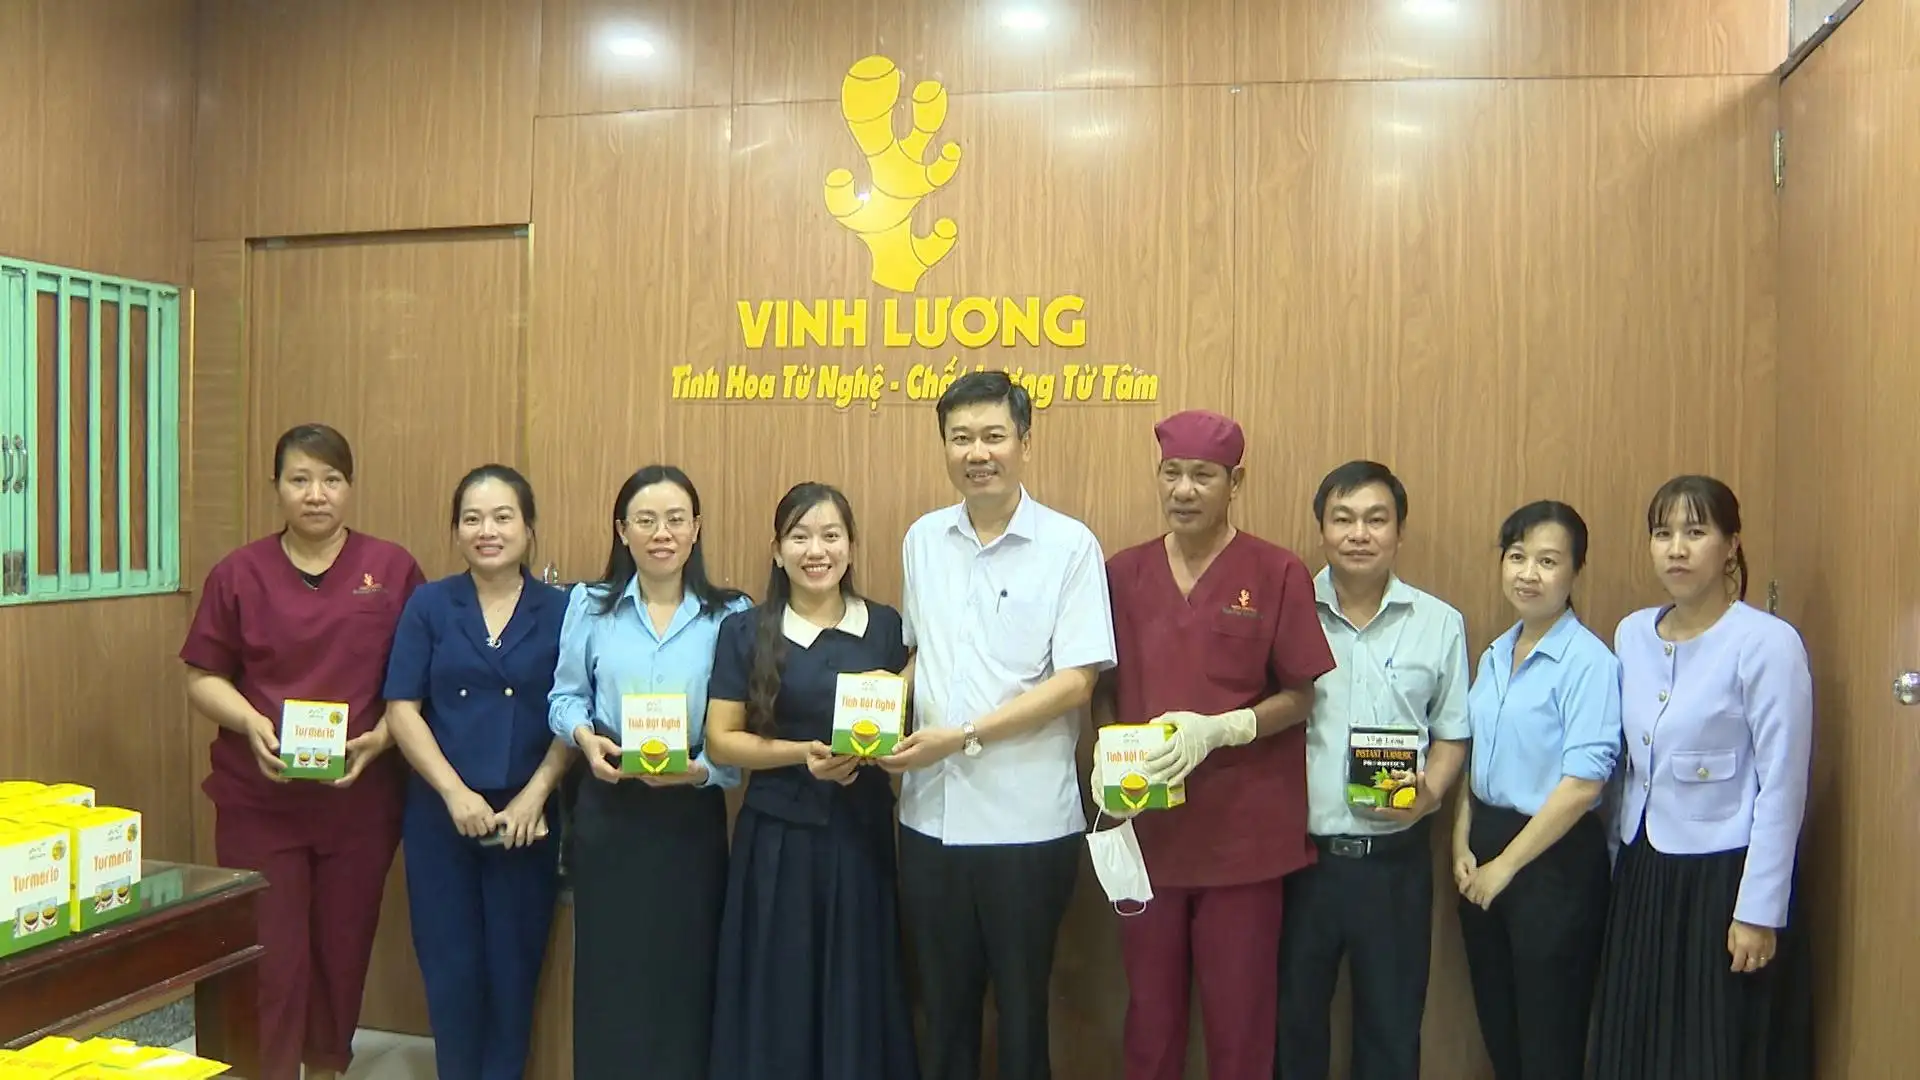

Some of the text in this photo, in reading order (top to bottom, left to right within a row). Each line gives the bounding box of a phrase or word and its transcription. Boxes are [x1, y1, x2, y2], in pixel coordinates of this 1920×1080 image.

[737, 294, 1086, 349] VINH LƯƠNG
[725, 364, 776, 400] Hoa
[783, 363, 815, 400] Từ
[817, 363, 885, 410] Nghệ
[1063, 363, 1098, 400] Từ
[1102, 362, 1159, 400] Tâm
